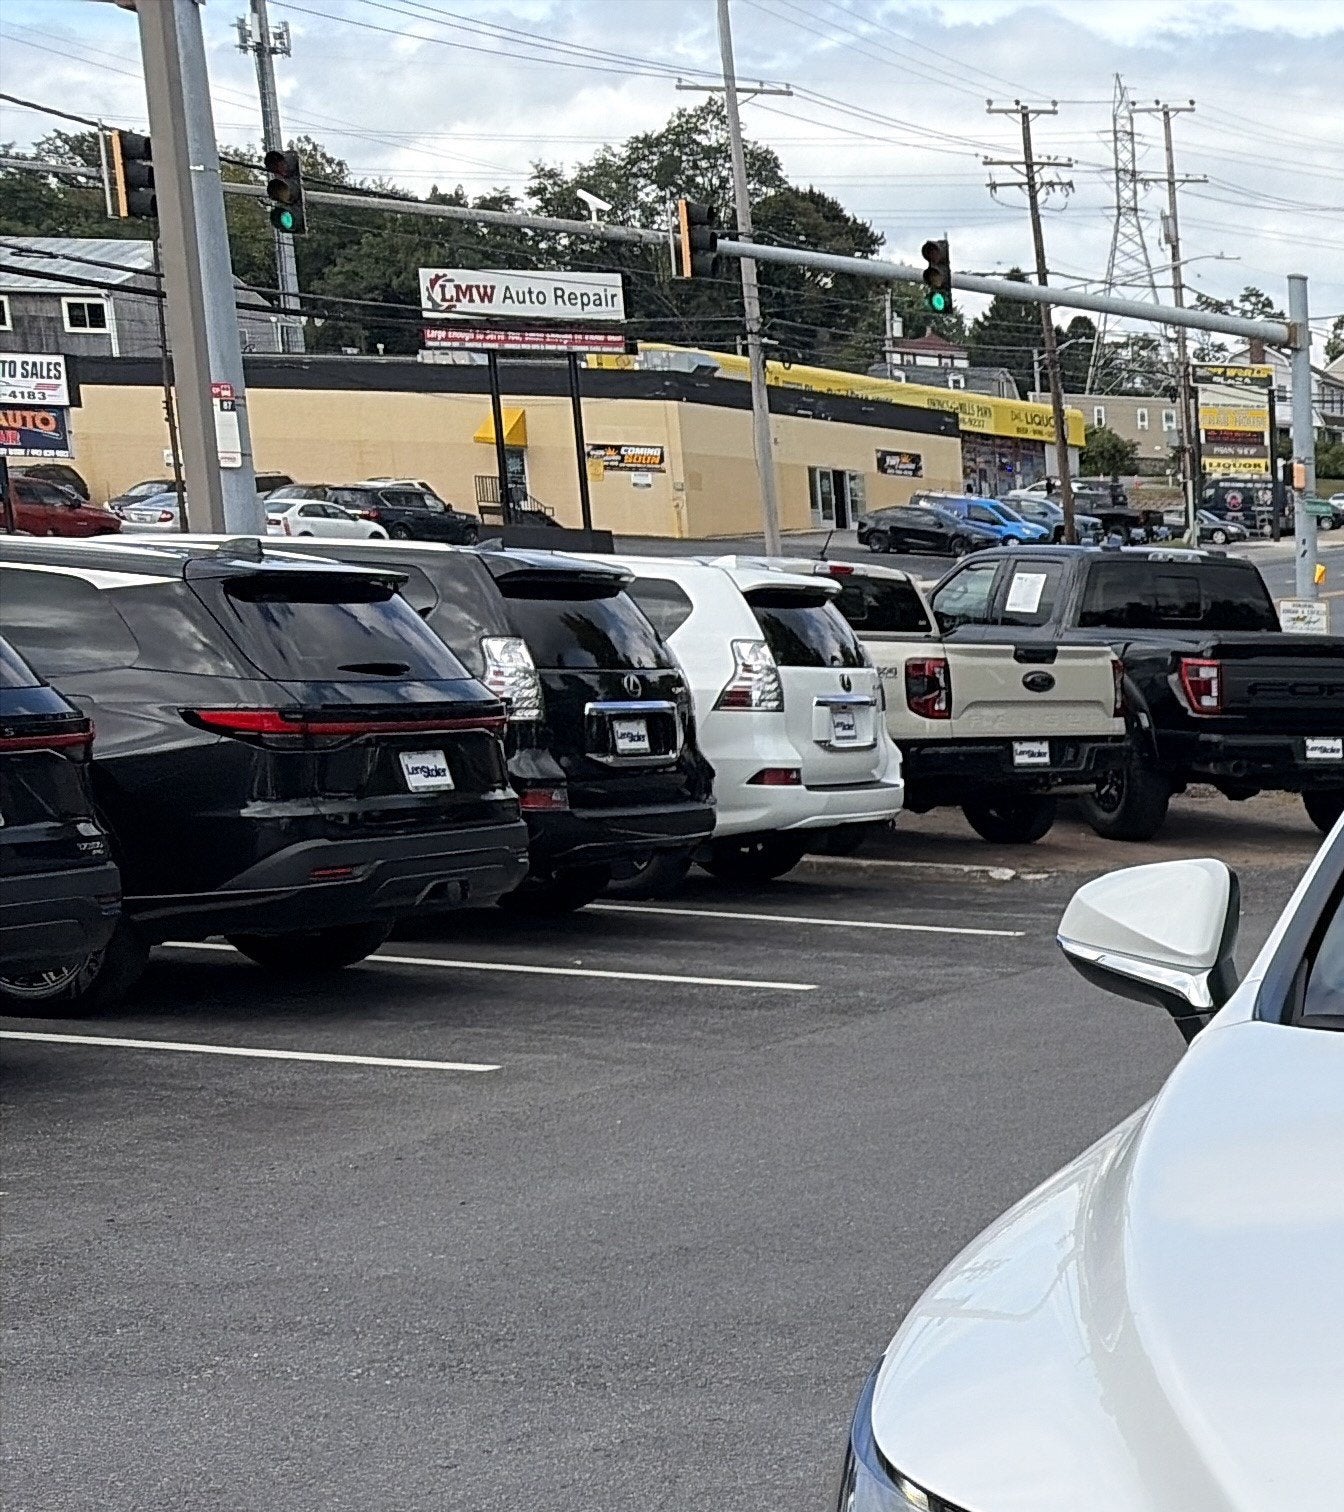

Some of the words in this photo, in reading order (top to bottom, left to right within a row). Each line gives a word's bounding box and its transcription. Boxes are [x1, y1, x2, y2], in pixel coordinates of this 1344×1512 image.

[439, 284, 497, 305] LMW
[502, 285, 547, 305] Auto
[553, 287, 618, 312] Repair
[20, 360, 62, 380] SALES
